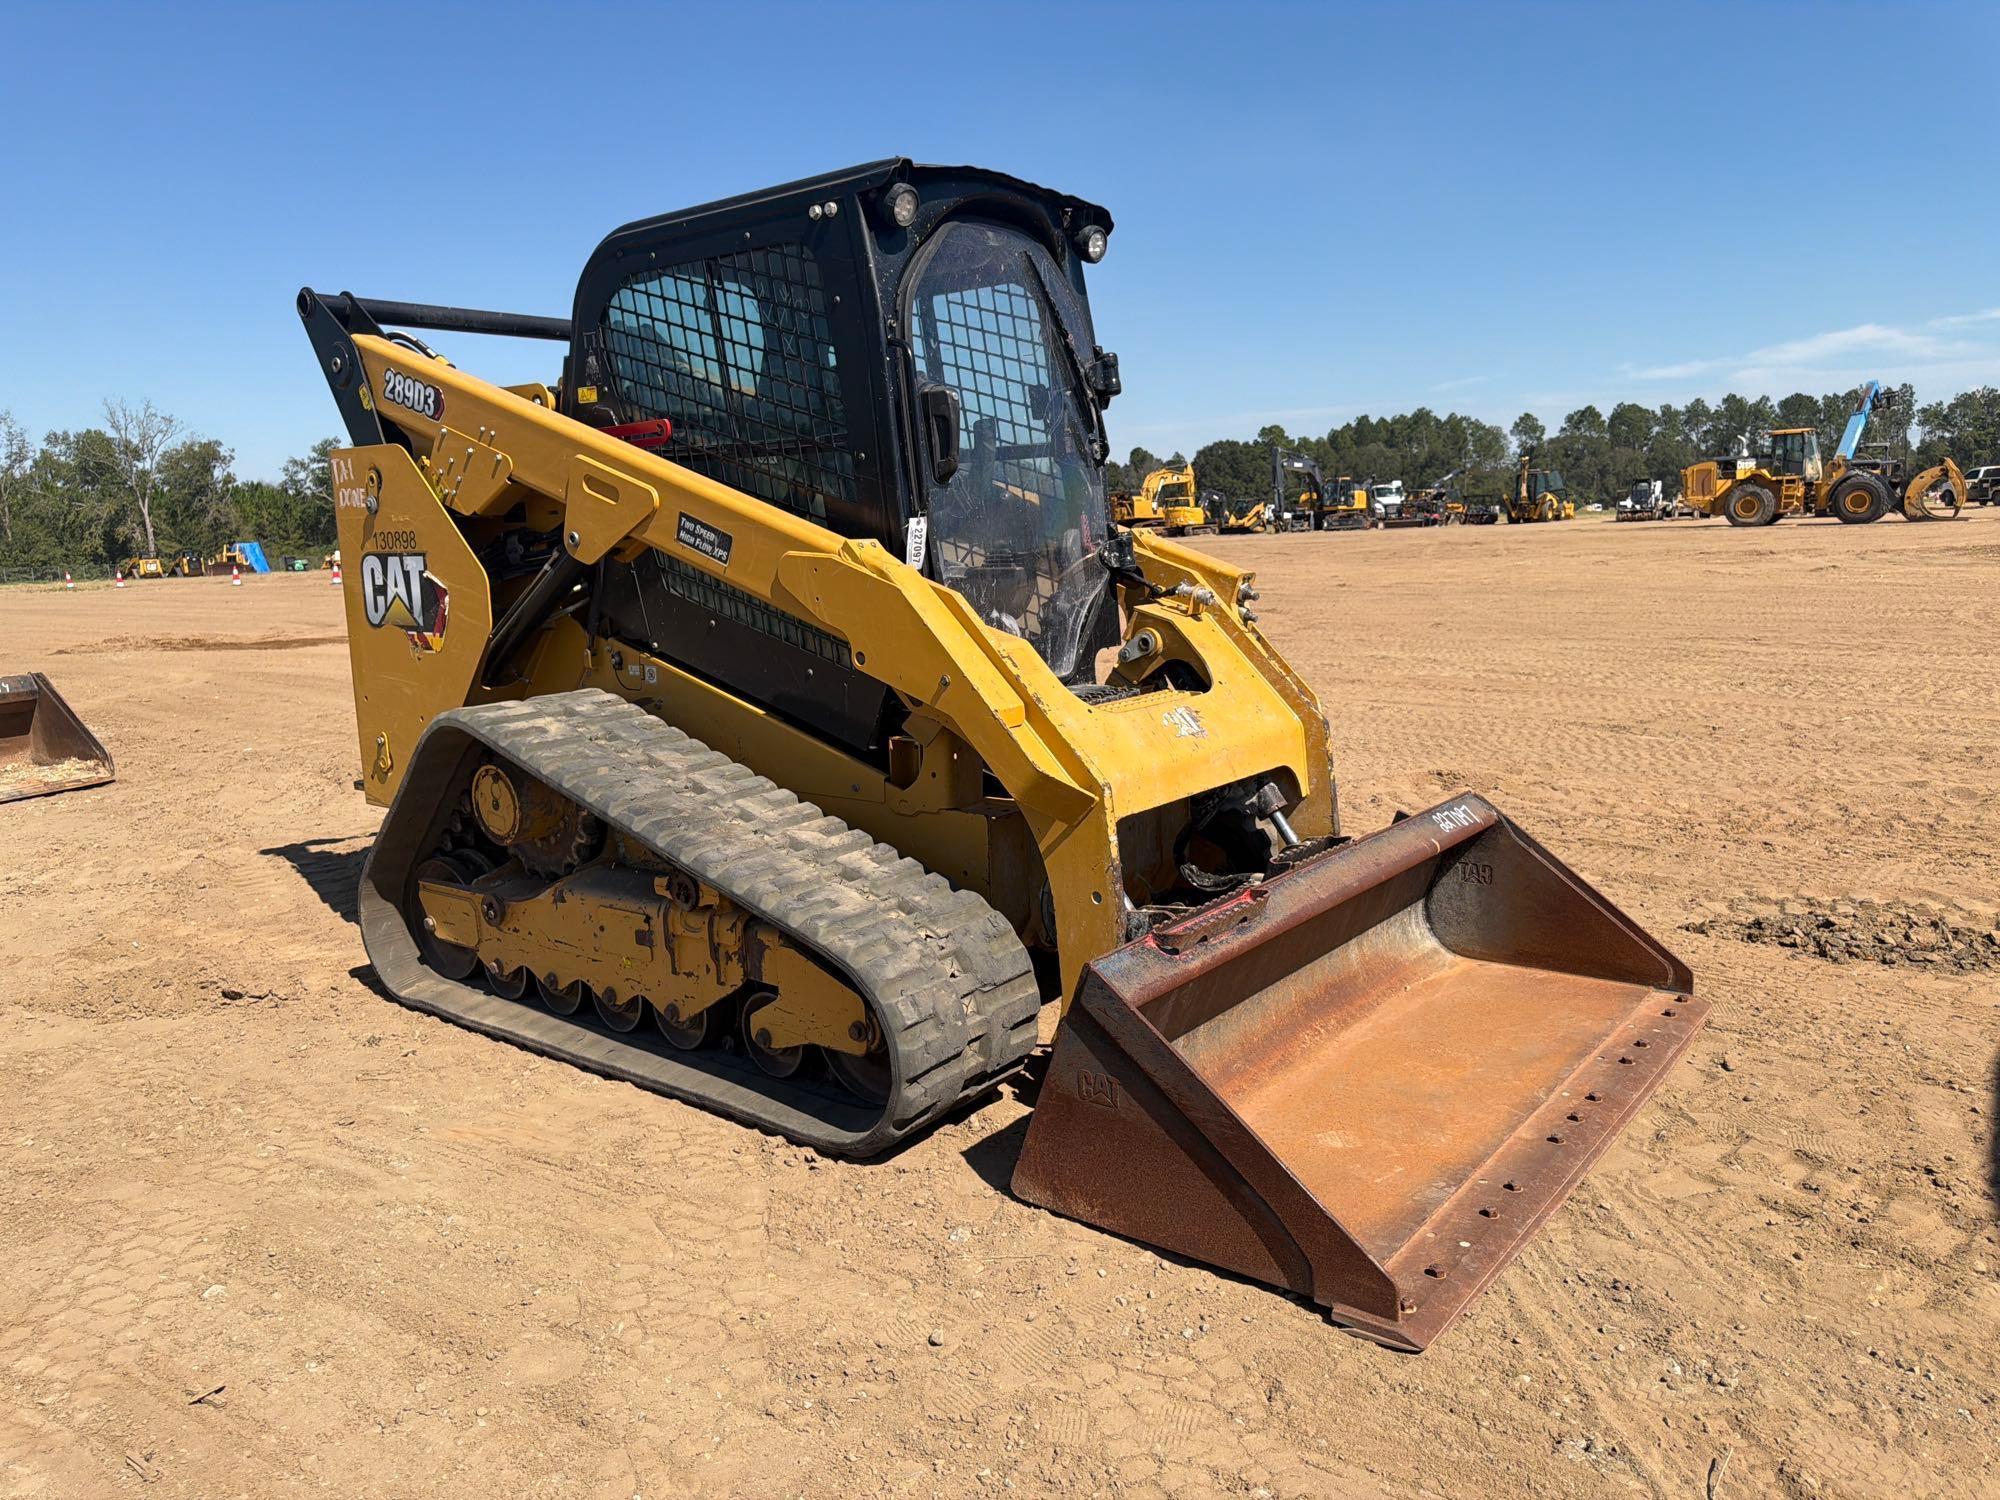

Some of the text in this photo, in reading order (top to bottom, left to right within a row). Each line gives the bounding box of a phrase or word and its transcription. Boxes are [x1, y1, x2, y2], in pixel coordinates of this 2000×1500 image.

[384, 369, 436, 417] 289D3
[339, 487, 367, 508] DONE
[713, 546, 728, 560] XPS
[913, 528, 923, 563] 227097
[362, 554, 425, 628] CAT
[1077, 1069, 1120, 1110] CAT
